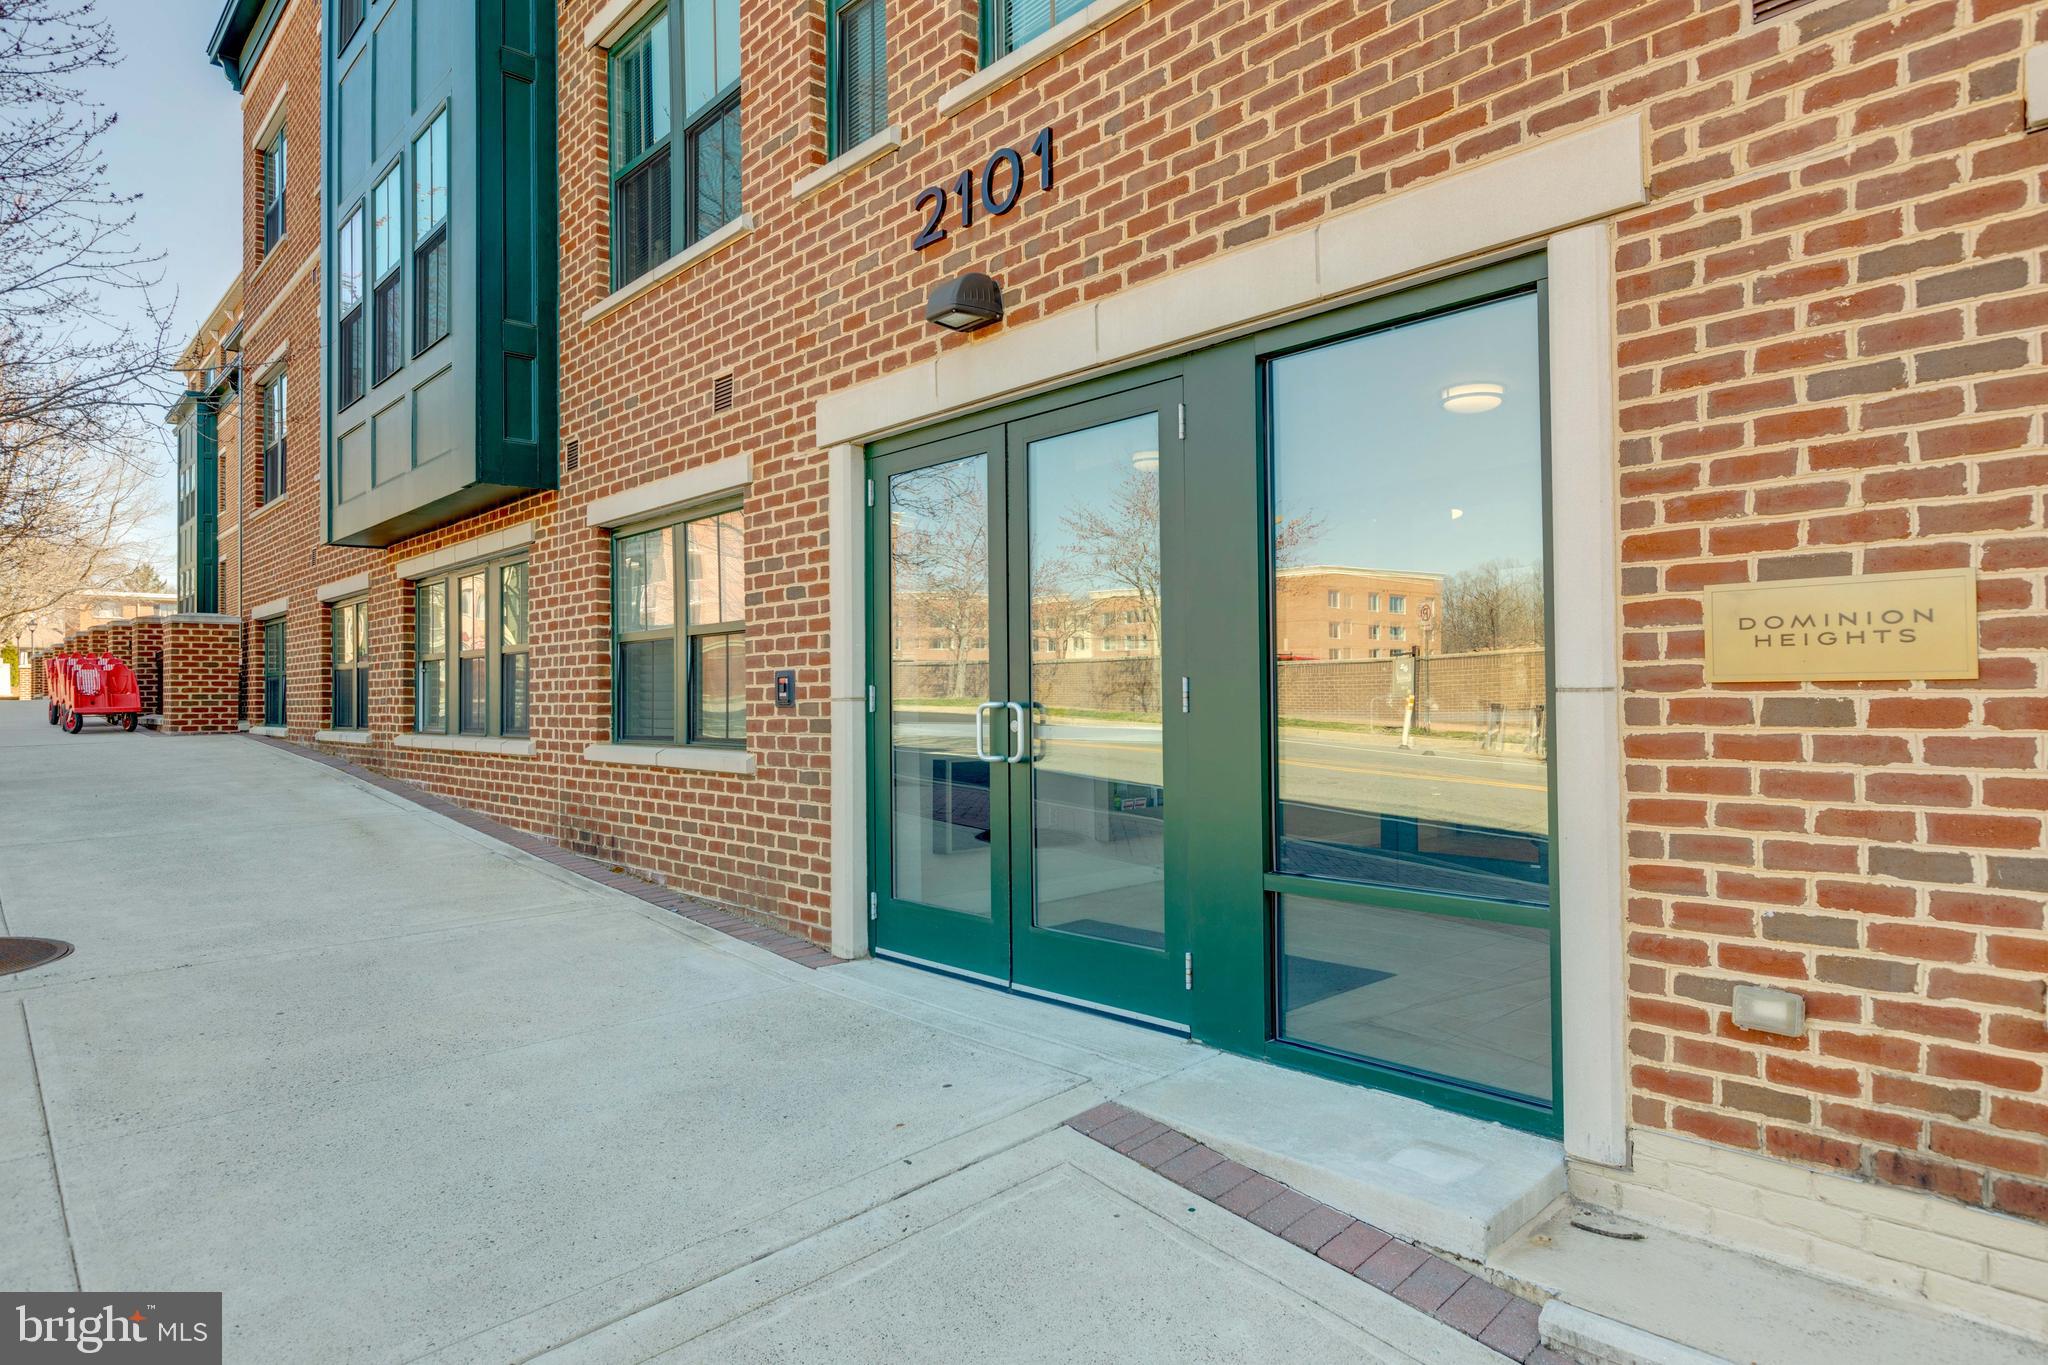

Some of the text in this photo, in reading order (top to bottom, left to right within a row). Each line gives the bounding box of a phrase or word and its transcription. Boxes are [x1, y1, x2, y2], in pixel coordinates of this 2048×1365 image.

[913, 127, 1053, 251] 2101
[1738, 608, 1935, 631] DOMINION
[1754, 628, 1917, 648] HEIGHTS
